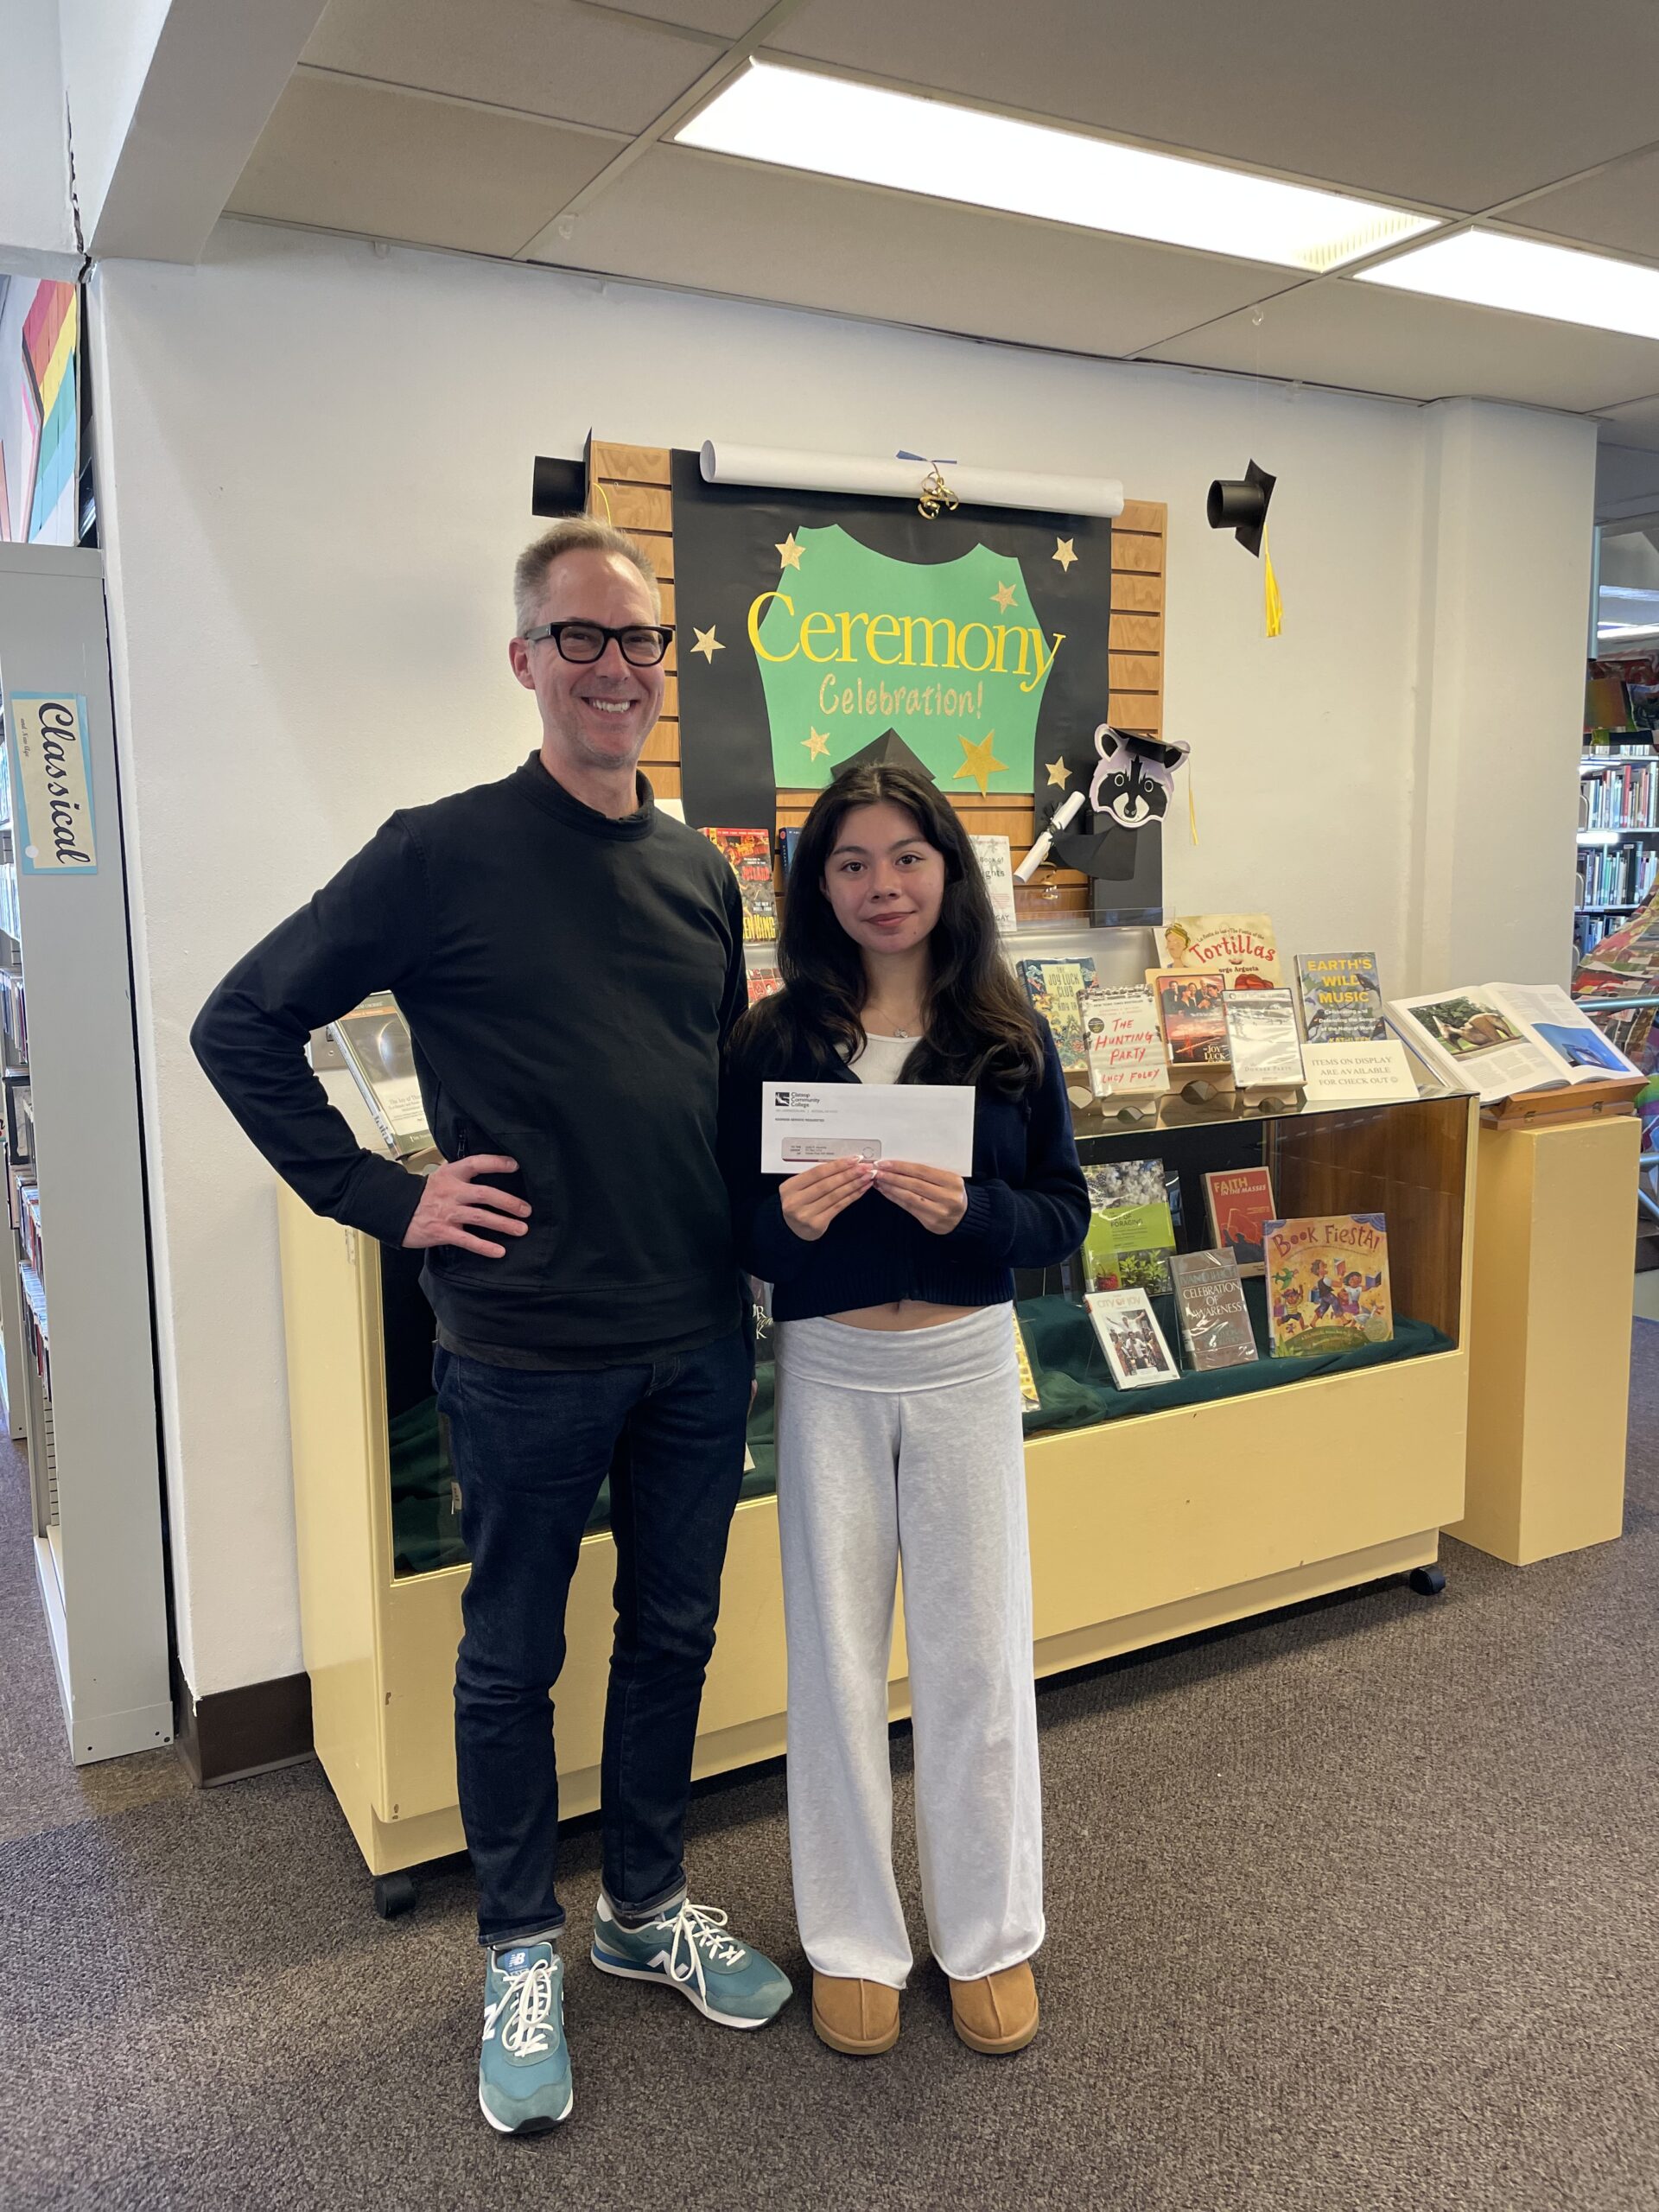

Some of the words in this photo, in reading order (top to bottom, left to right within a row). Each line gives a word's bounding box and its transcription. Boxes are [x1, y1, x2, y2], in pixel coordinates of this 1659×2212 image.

[747, 591, 1066, 692] Ceremony
[819, 673, 983, 719] Celebration!
[38, 702, 91, 864] Classical
[754, 914, 776, 939] KING
[1189, 934, 1276, 963] Tortillas
[1307, 958, 1373, 971] EARTH'S
[1048, 974, 1062, 986] JOY
[1062, 973, 1080, 986] LUCK
[1057, 985, 1075, 998] CLUB
[1319, 991, 1370, 1003] MUSIC
[1112, 1018, 1135, 1033] THE
[1095, 1031, 1154, 1052] HUNTING
[1109, 1047, 1147, 1065] PARTY
[1102, 1073, 1124, 1084] LUCY
[1129, 1068, 1160, 1084] FOLEY
[1340, 1066, 1391, 1076] AVAILABLE
[1213, 1177, 1248, 1193] FAITH
[1241, 1184, 1267, 1193] MASSES
[1183, 1281, 1240, 1300] CELEBRATION
[1097, 1299, 1115, 1307] CITY
[1127, 1296, 1141, 1306] JOY
[1206, 1295, 1219, 1306] OF
[1192, 1301, 1243, 1319] AWARENESS
